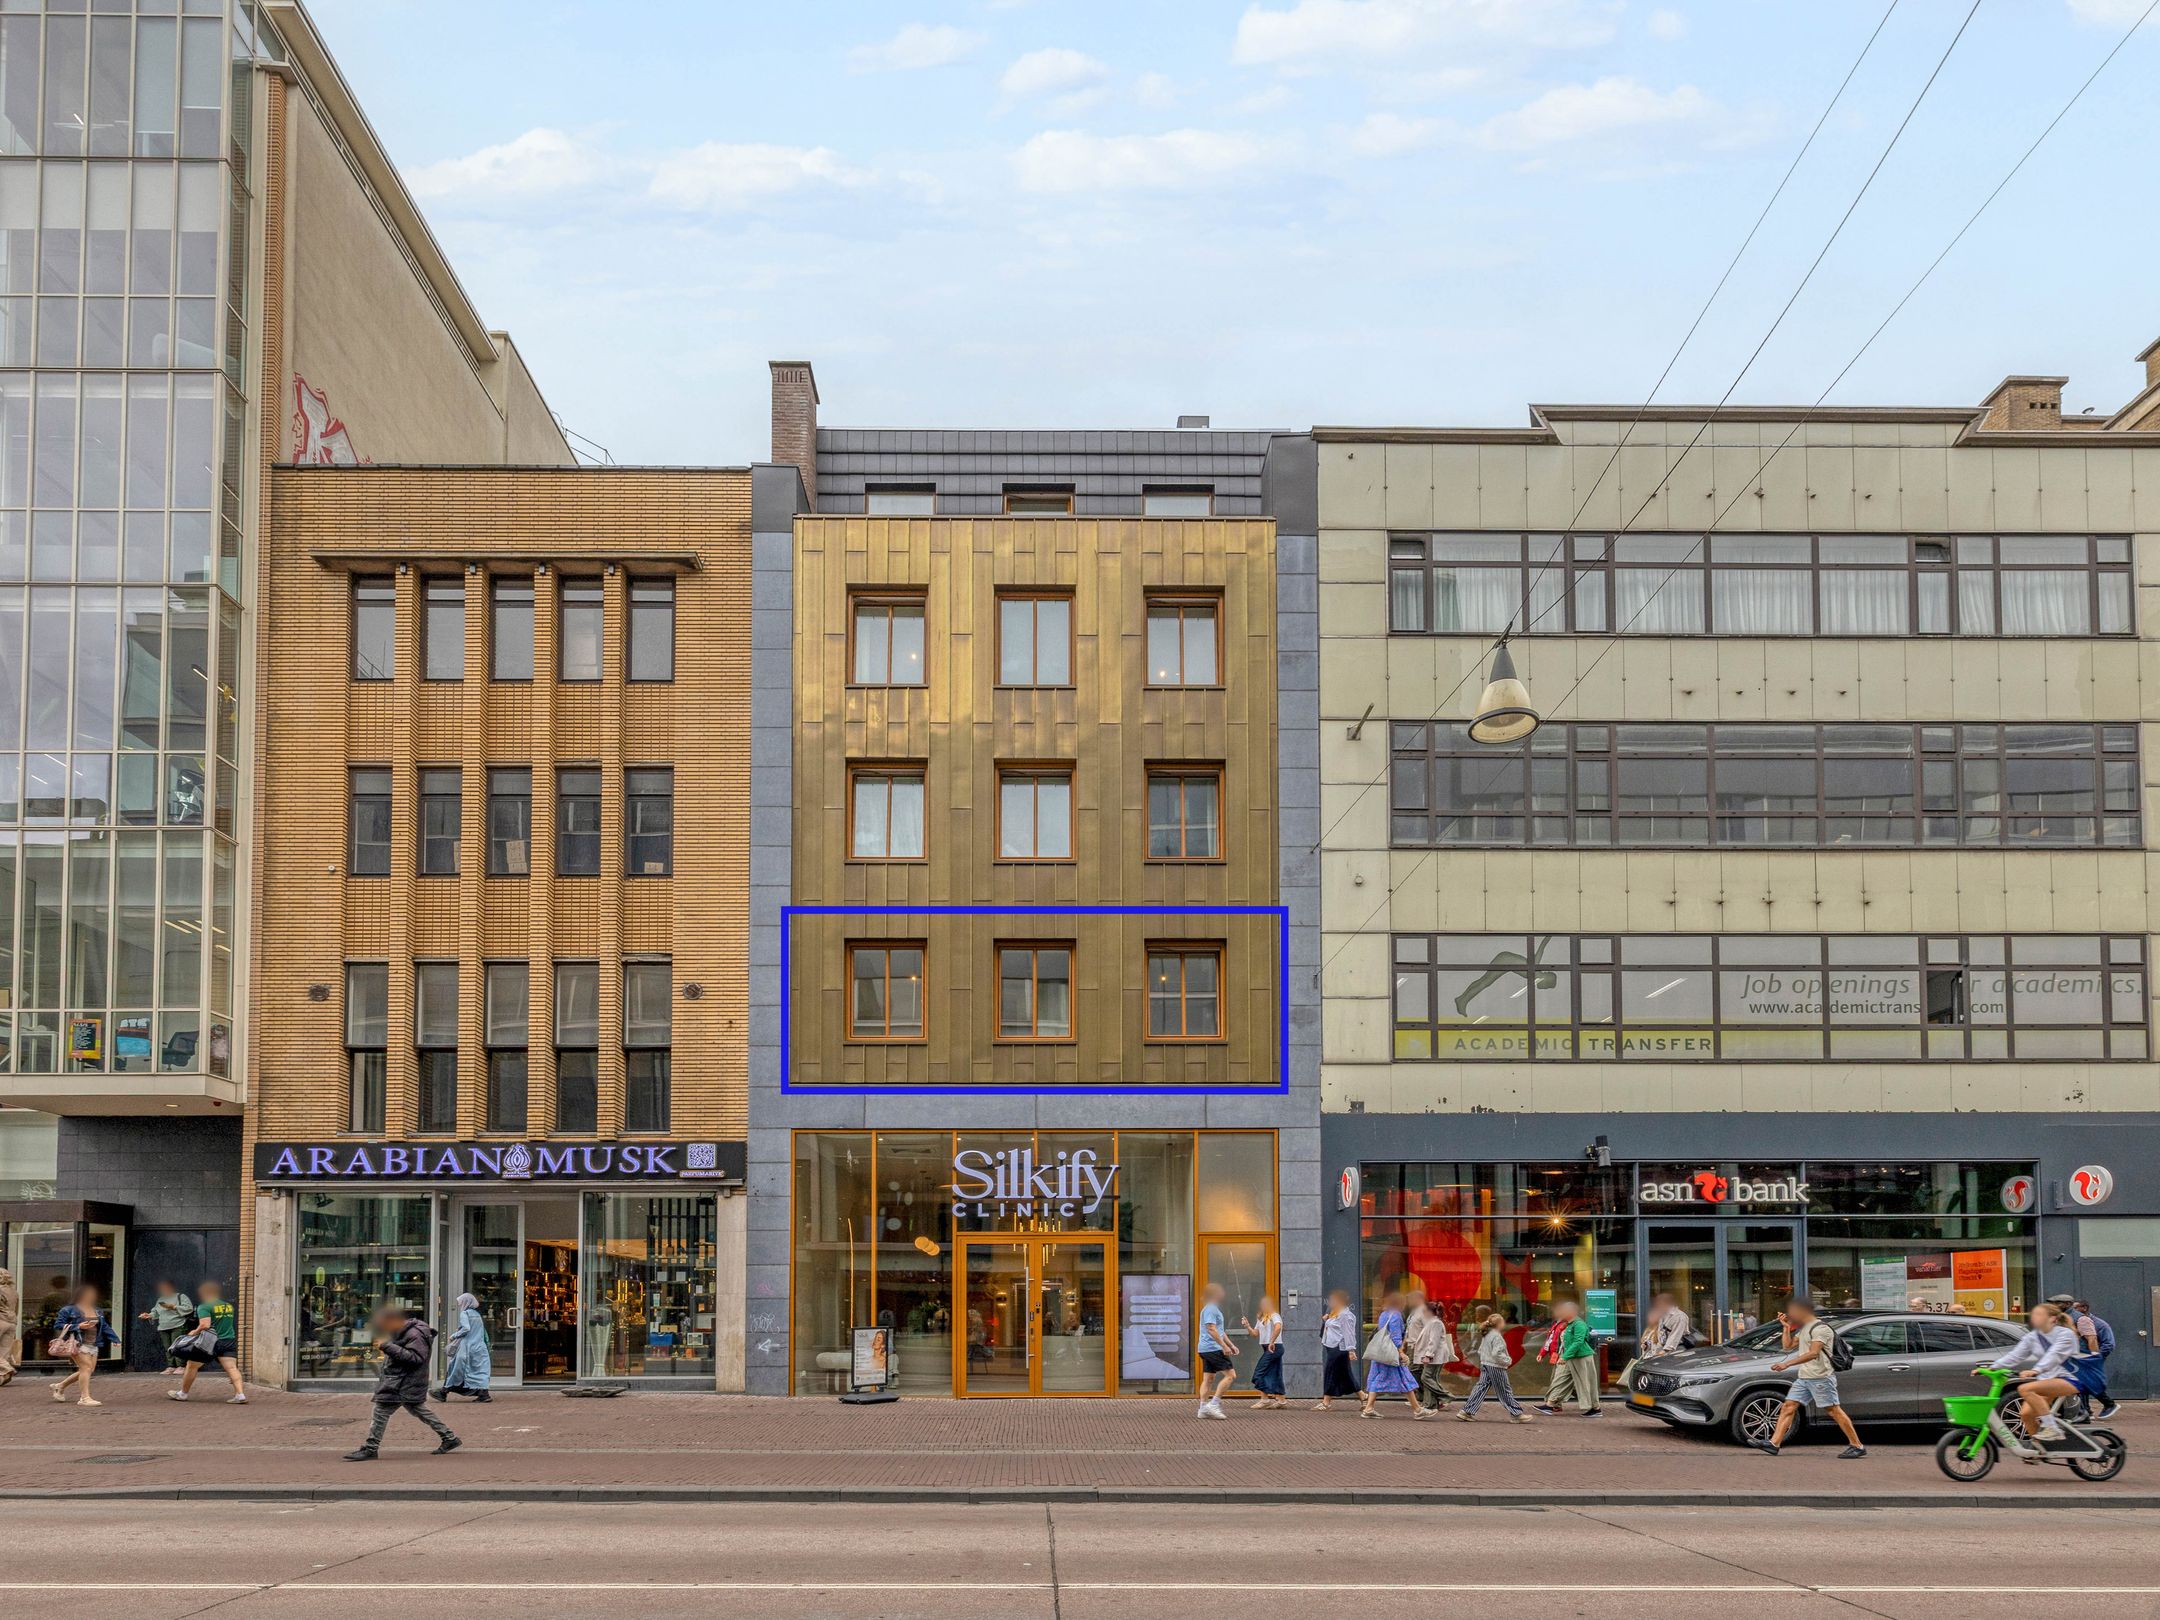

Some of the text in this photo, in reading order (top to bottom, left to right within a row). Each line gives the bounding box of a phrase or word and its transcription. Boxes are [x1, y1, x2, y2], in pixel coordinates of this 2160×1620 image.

[1741, 973, 1782, 999] Job
[1792, 974, 1911, 999] openings
[1992, 972, 2142, 994] academics.
[1455, 1037, 1712, 1051] ACADEMIC TRANSFER
[268, 1146, 678, 1174] ARABIAN MUSK
[951, 1148, 1120, 1215] Silkify
[1640, 1176, 1811, 1202] asn bank
[951, 1202, 1075, 1218] CLINIC
